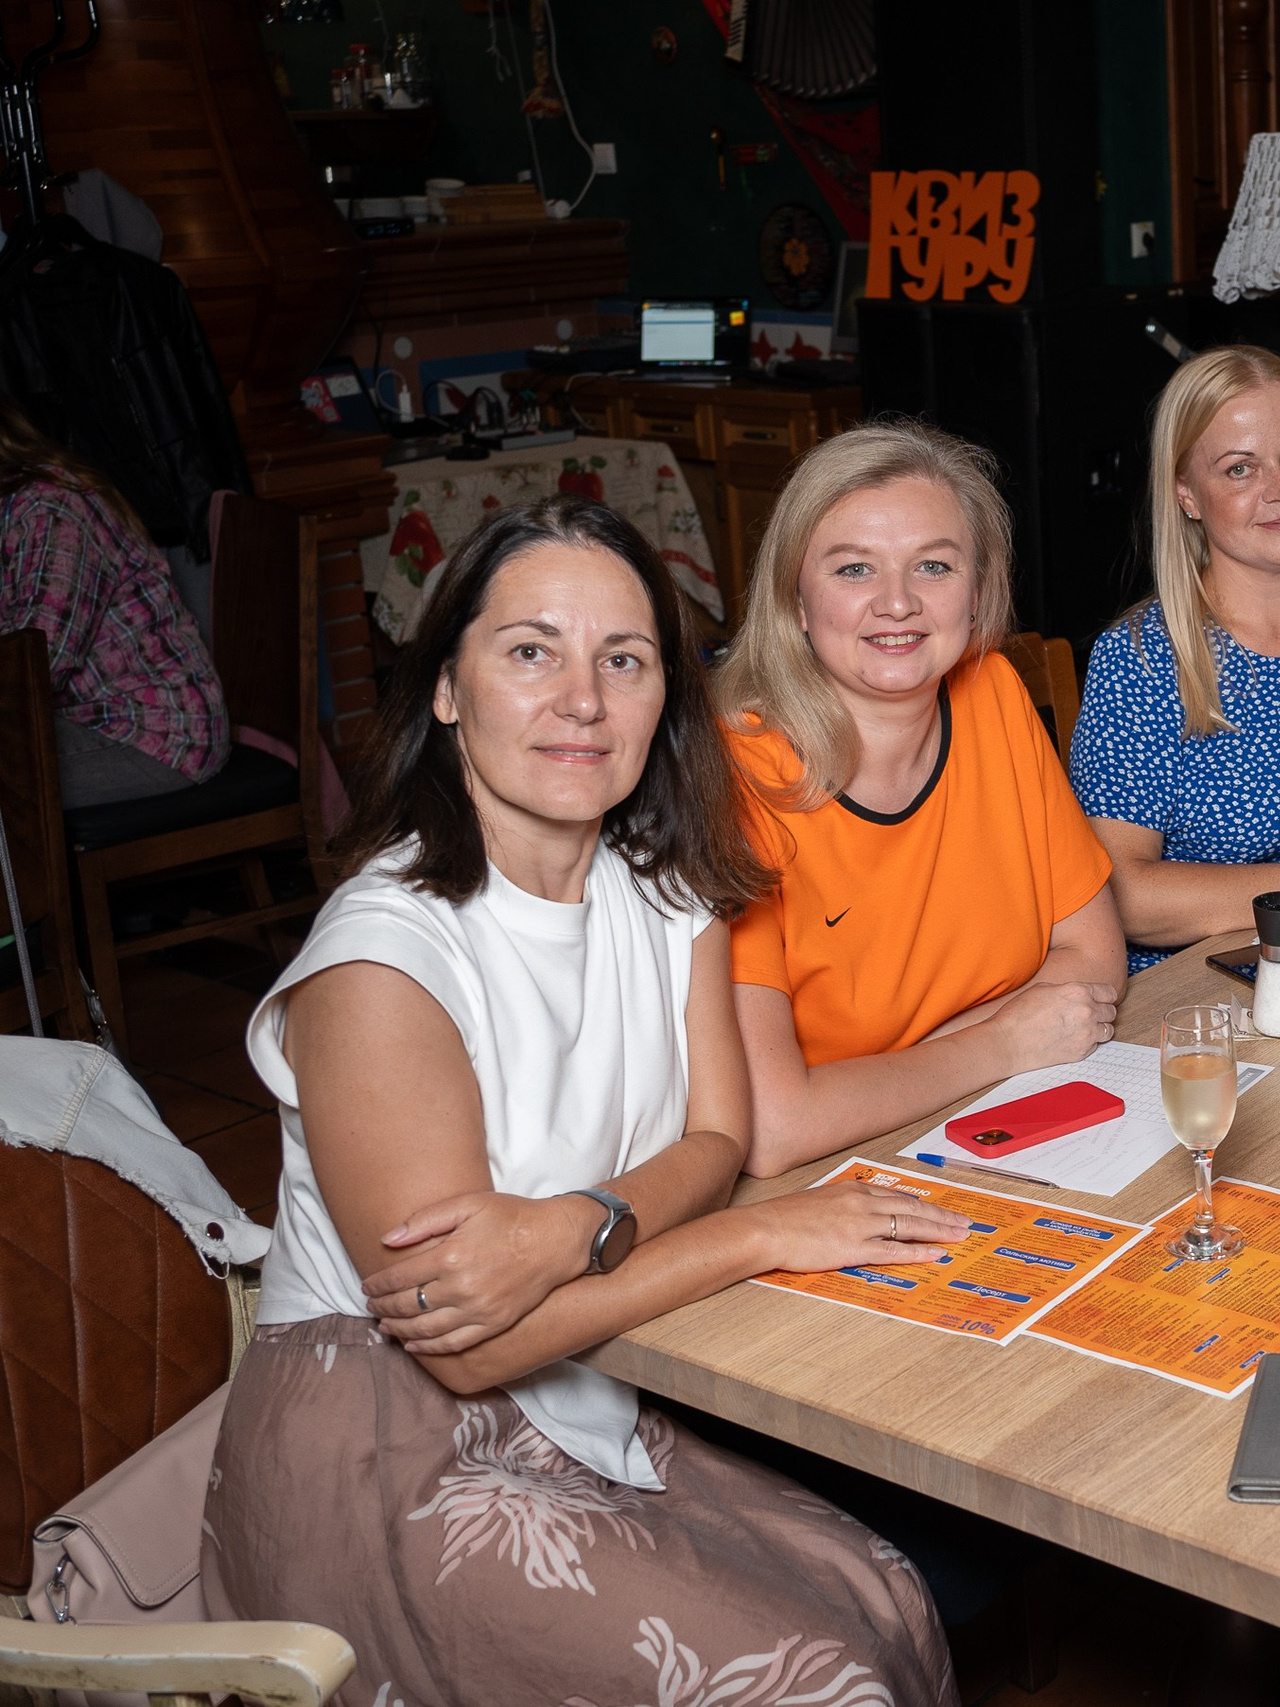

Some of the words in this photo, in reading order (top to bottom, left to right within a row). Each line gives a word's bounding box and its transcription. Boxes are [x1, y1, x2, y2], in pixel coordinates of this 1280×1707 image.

[870, 169, 1041, 237] КВИЗ
[864, 234, 1035, 303] ГУРУ
[895, 1183, 931, 1197] МЕНЮ
[999, 1248, 1038, 1262] Сельские
[1038, 1257, 1072, 1269] мотивы
[972, 1285, 1007, 1298] Десерт
[958, 1319, 996, 1335] 10%
